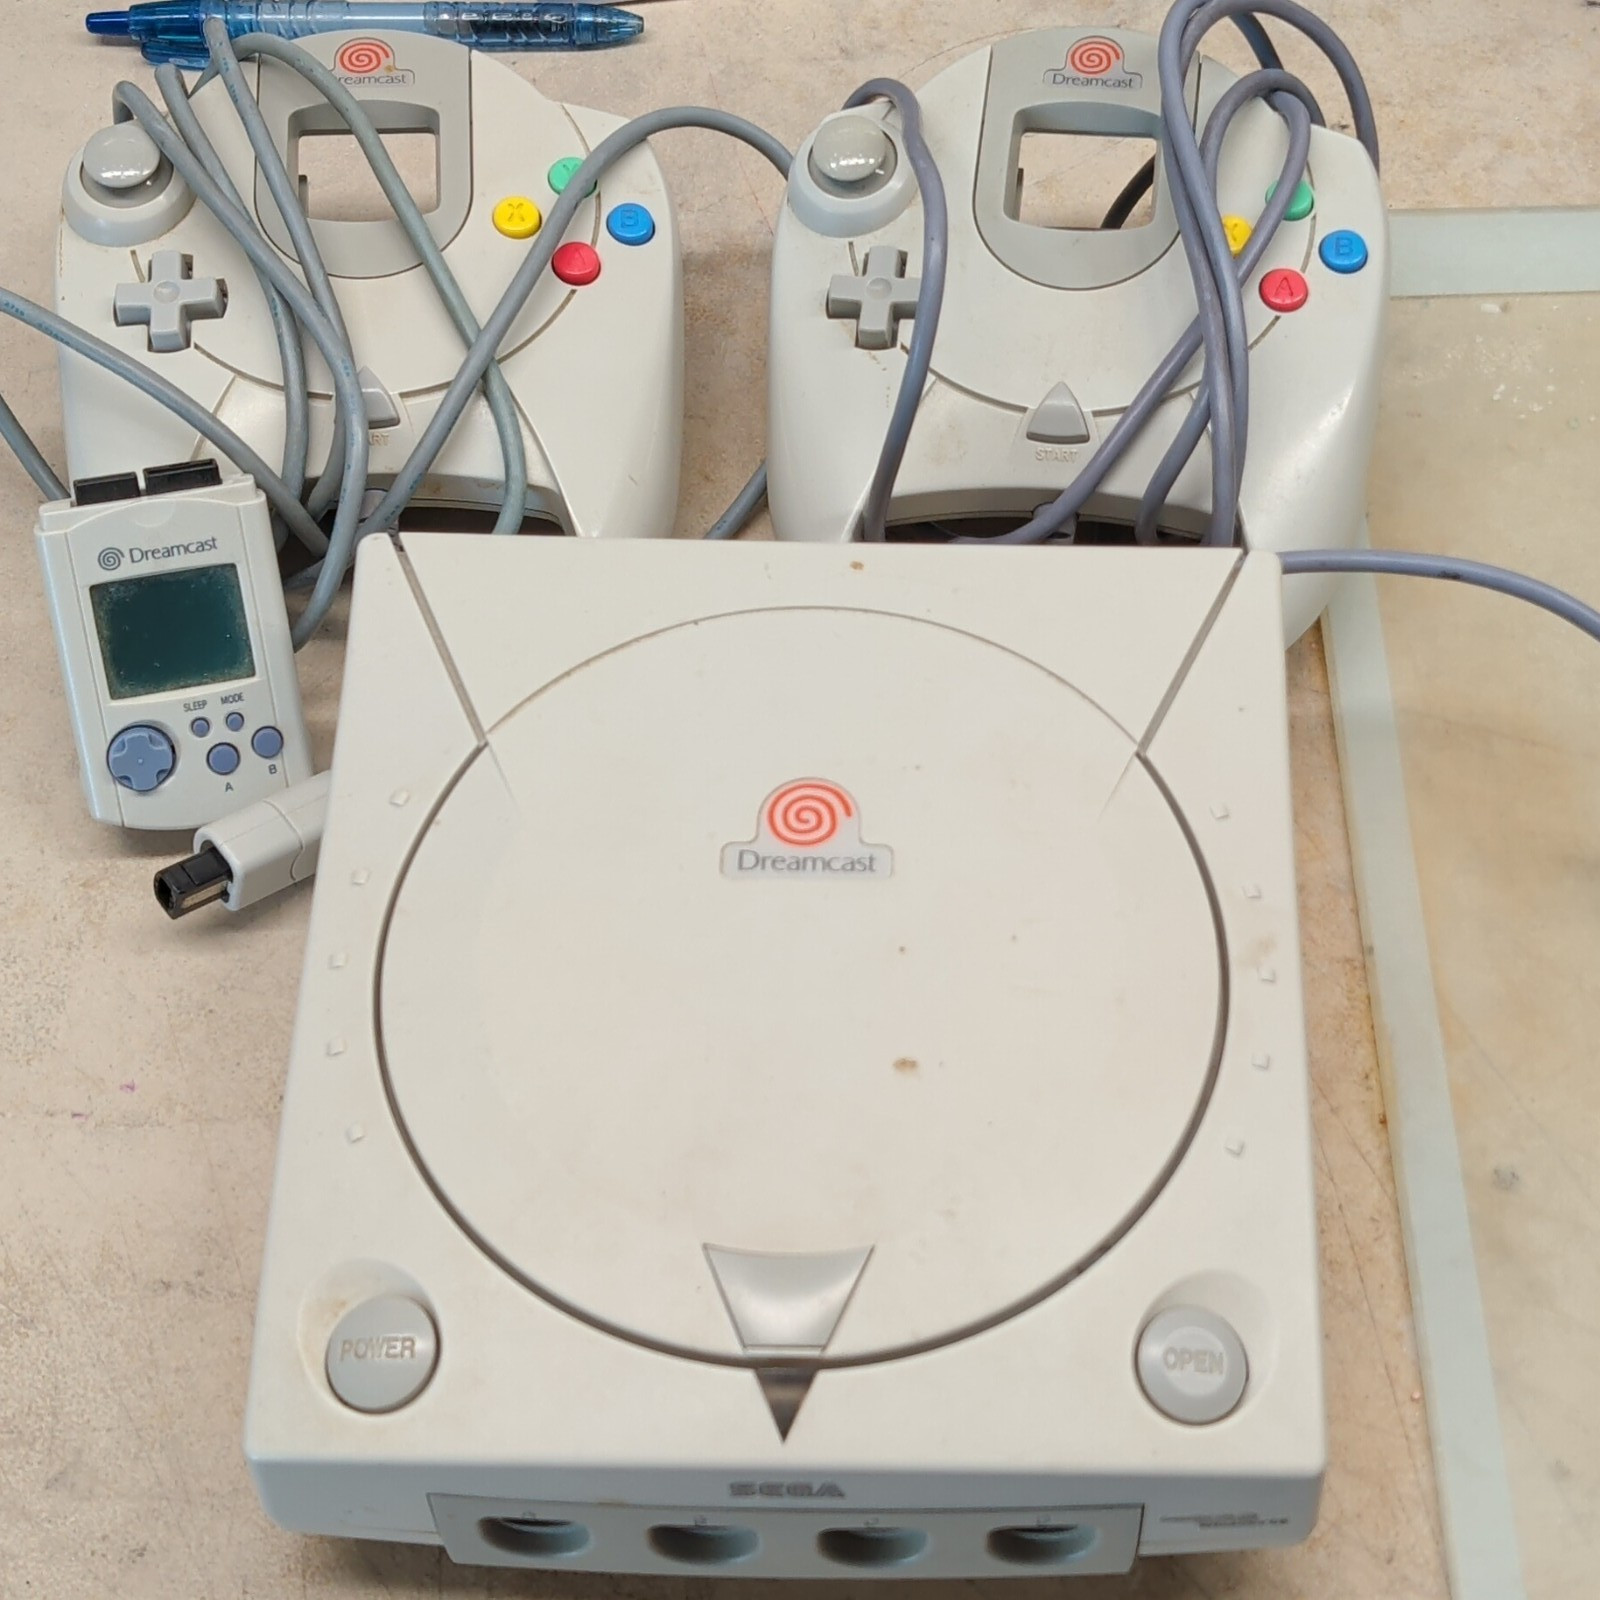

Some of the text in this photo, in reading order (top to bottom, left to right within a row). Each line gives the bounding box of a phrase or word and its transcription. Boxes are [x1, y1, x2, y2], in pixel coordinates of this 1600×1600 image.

[337, 74, 407, 85] reamcast
[1053, 73, 1134, 88] Dreamcast
[507, 202, 525, 222] X
[620, 209, 639, 229] B
[1334, 236, 1354, 256] B
[1273, 276, 1295, 297] A
[1035, 447, 1079, 463] START
[128, 536, 219, 564] Dreamcast
[183, 699, 208, 713] SLEEP
[220, 692, 245, 705] MODE
[268, 763, 278, 775] B
[224, 782, 234, 793] A
[737, 849, 877, 873] Dreamcast
[340, 1334, 417, 1362] POWER
[1162, 1346, 1225, 1375] OPEN
